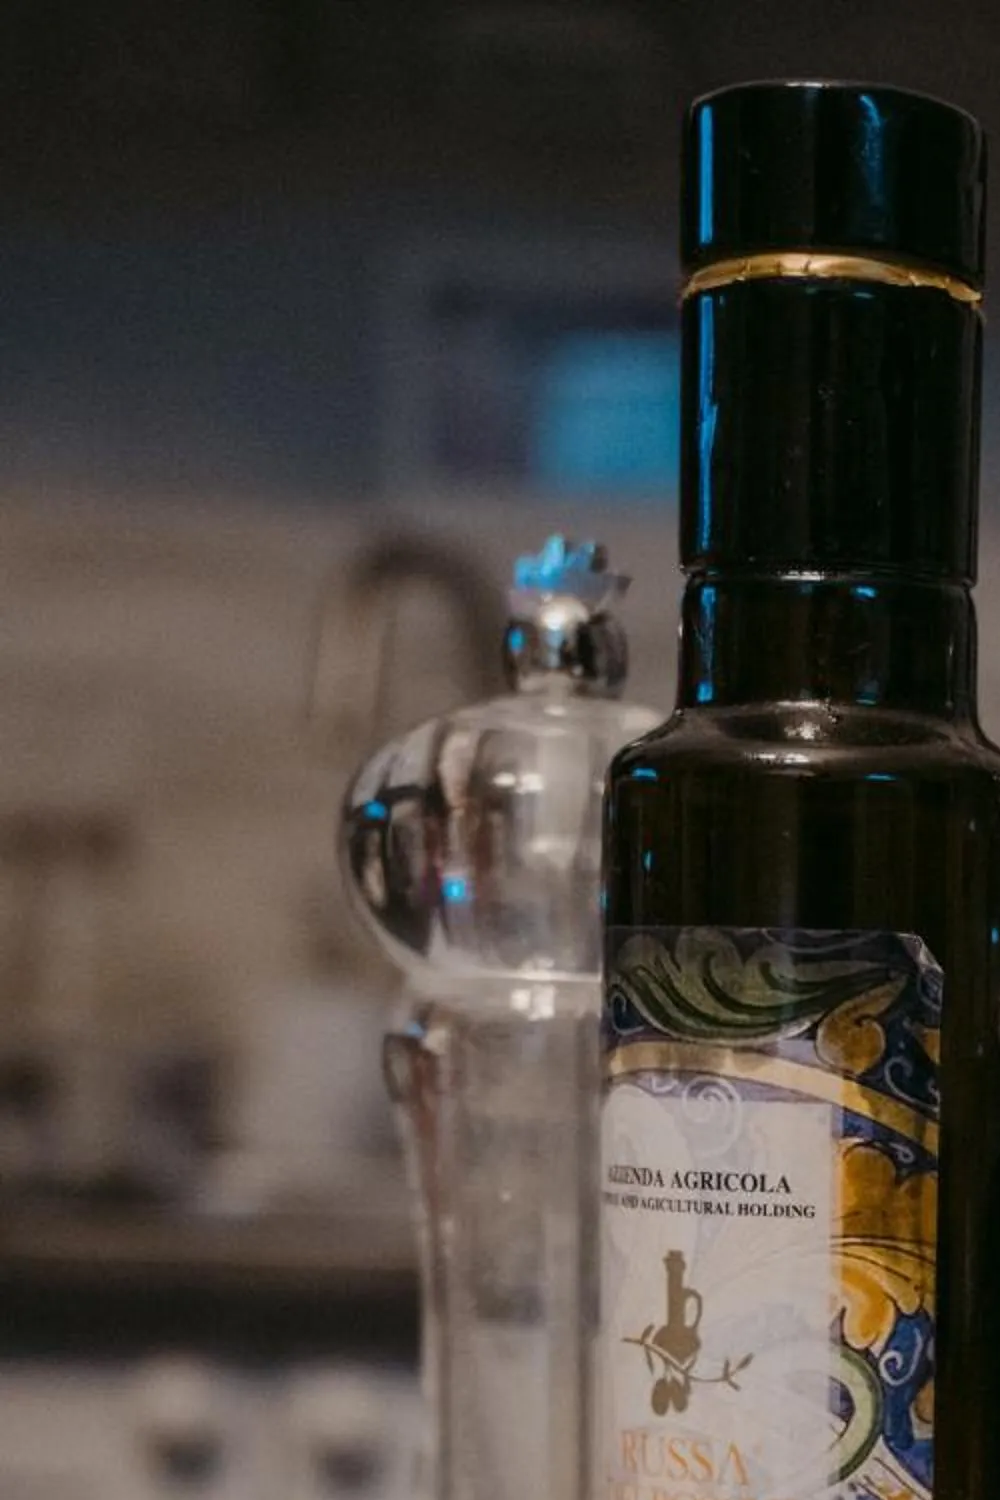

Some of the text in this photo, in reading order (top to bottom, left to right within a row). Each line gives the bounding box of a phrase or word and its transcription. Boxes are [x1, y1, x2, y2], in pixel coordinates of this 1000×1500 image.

[671, 1171, 792, 1194] AGRICOLA
[738, 1203, 816, 1219] HOLDING
[621, 1429, 749, 1487] RUSSA
